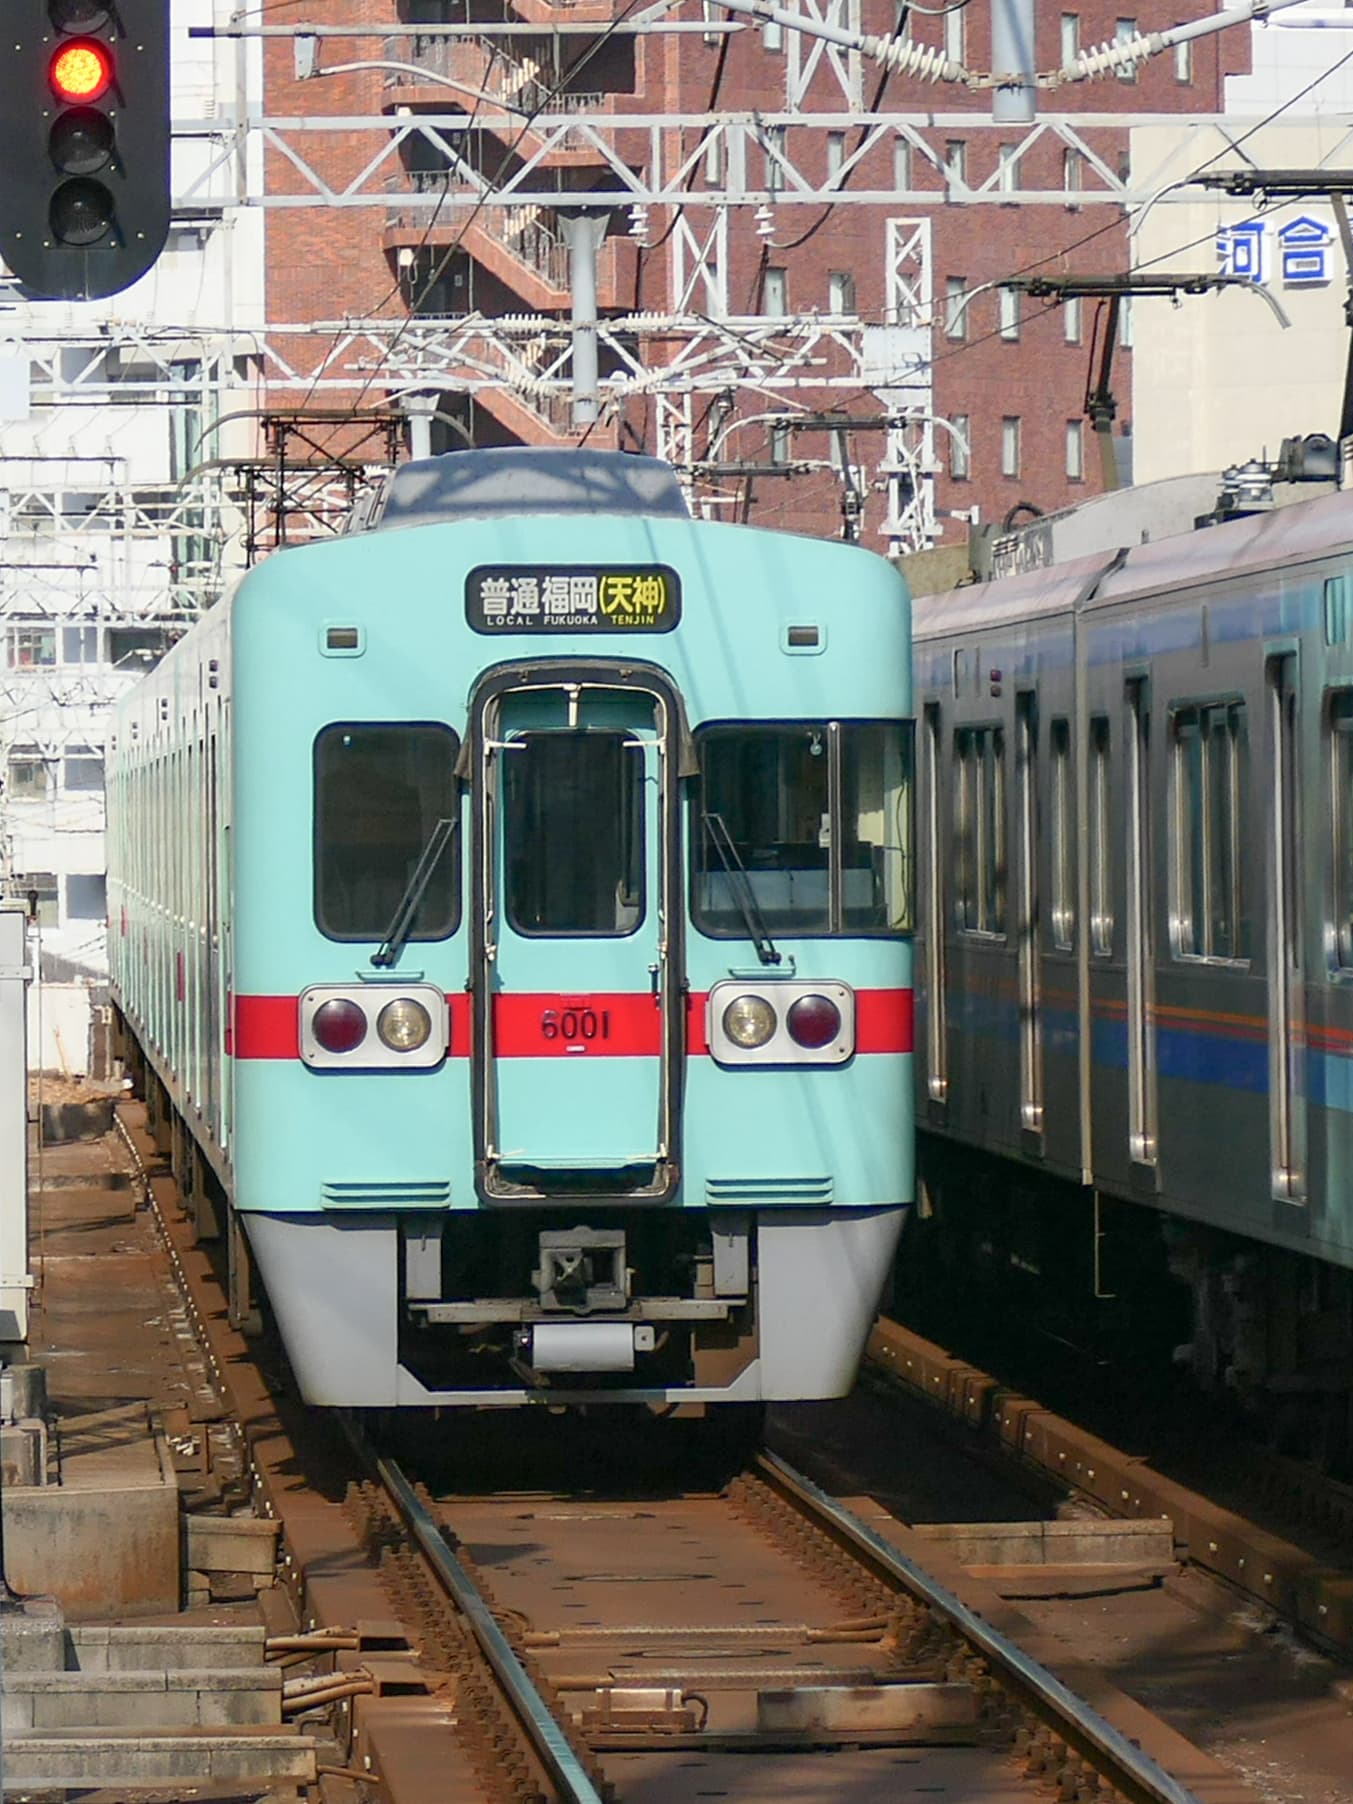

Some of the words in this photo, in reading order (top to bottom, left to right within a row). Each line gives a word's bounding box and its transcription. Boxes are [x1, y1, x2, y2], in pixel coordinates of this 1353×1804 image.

[487, 615, 534, 626] LOCAL
[543, 614, 599, 626] FUKUOKA
[611, 614, 655, 625] TENJIN
[541, 1009, 610, 1040] 6001
